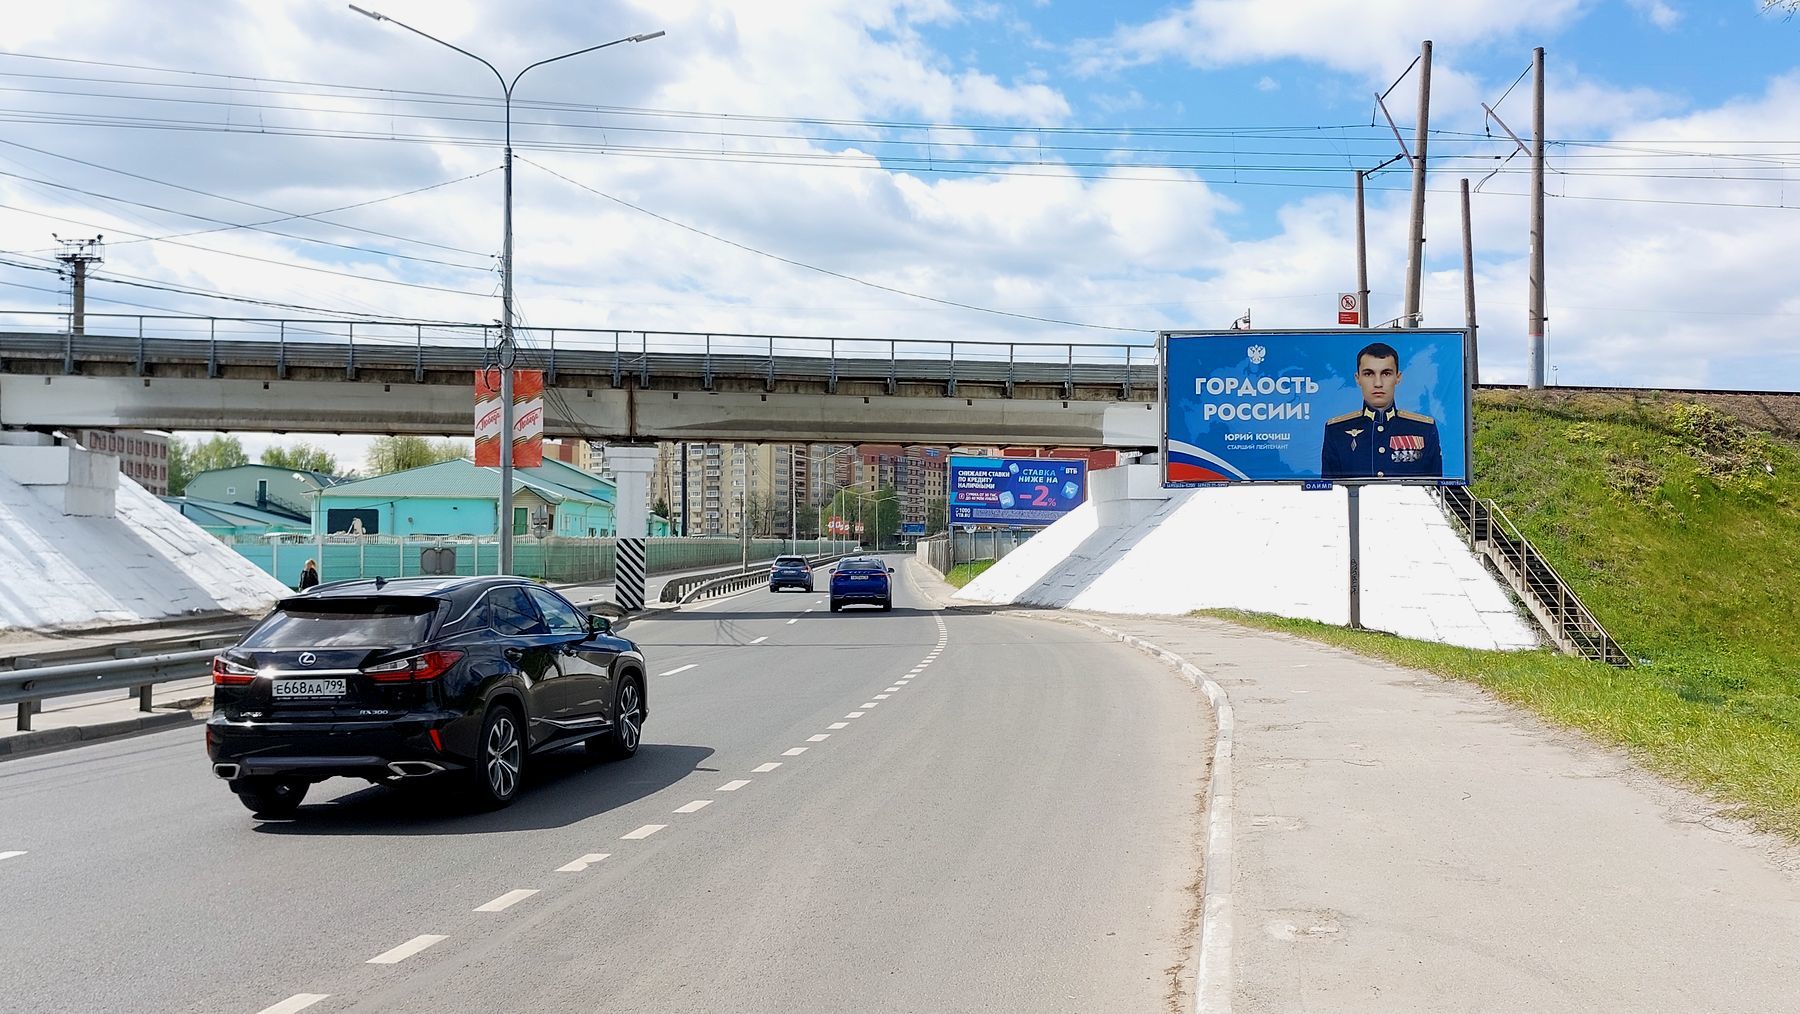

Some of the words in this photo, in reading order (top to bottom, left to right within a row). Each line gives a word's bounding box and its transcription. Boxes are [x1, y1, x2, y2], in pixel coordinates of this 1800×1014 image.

[1195, 376, 1319, 397] ГОРДОСТЬ
[1203, 402, 1311, 421] РОССИИ!
[1224, 431, 1253, 441] ЮРИЙ
[1255, 433, 1291, 441] КОЧИШ
[1022, 468, 1056, 476] СТАВКА
[1065, 467, 1078, 475] ВТБ
[1046, 476, 1059, 484] НА
[323, 680, 343, 690] 799
